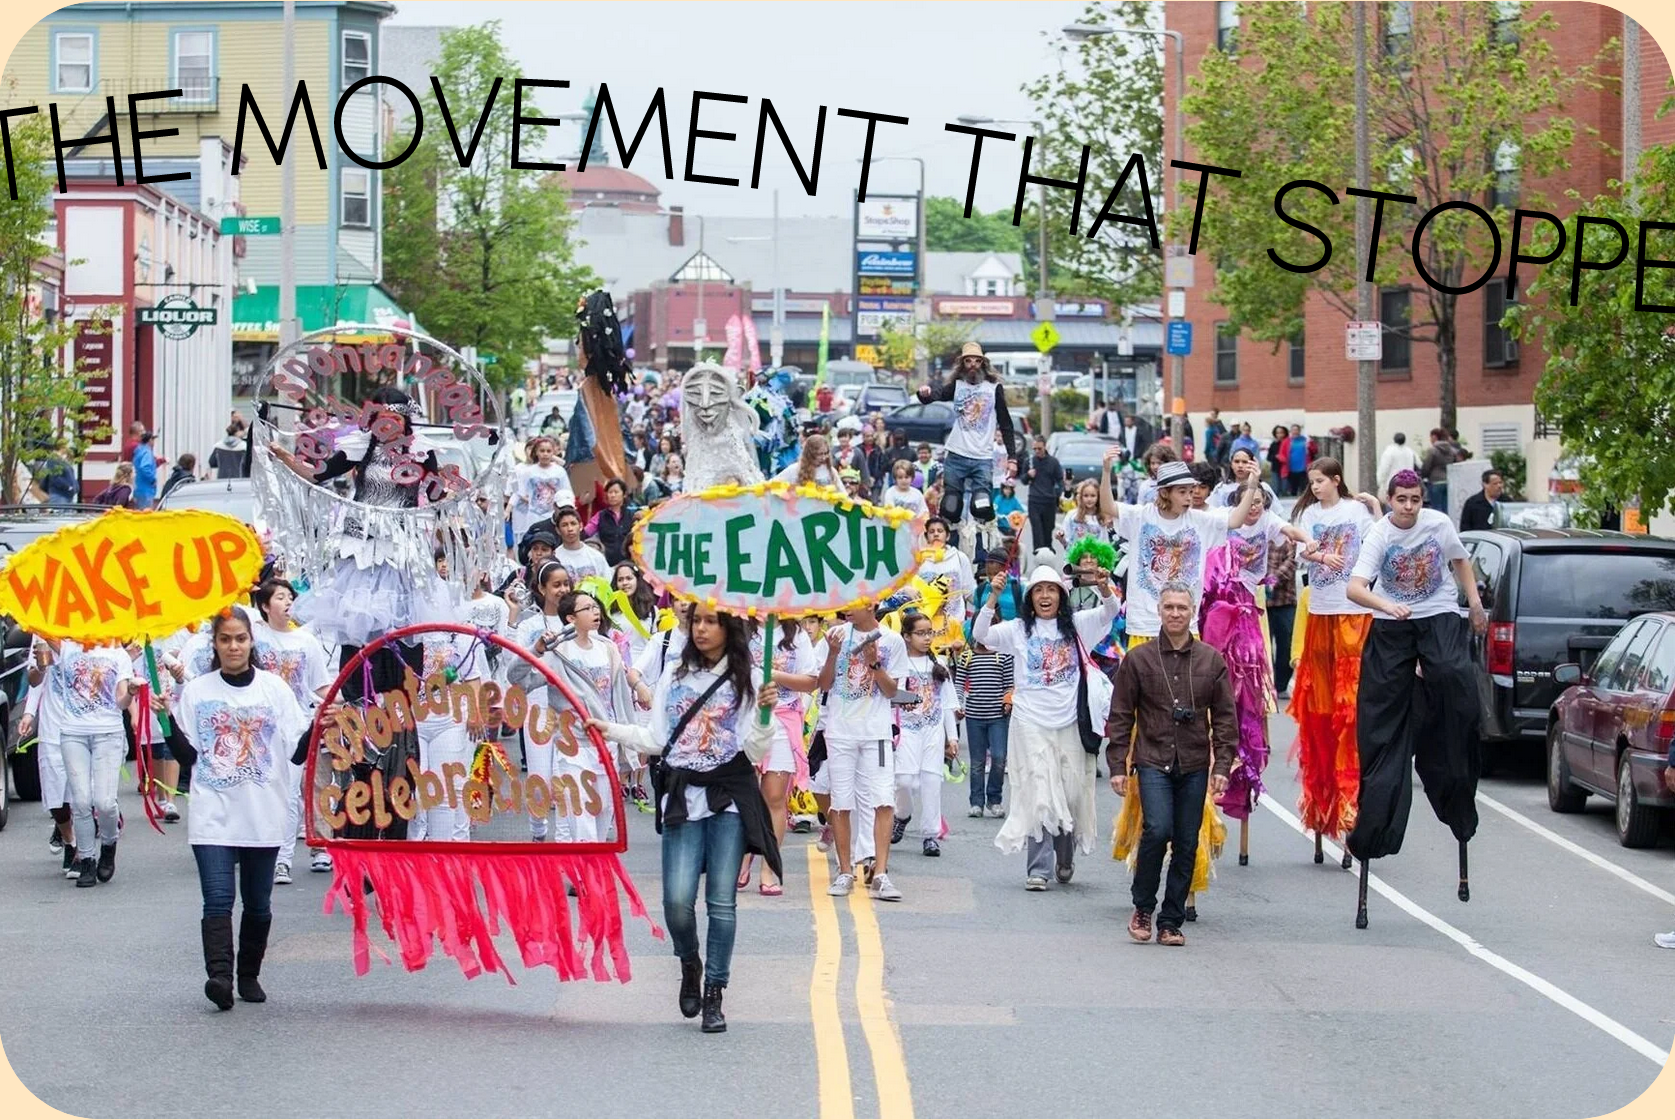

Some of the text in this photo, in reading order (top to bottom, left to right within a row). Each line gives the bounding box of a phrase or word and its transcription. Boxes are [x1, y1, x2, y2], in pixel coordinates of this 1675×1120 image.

[238, 219, 260, 232] WISE
[141, 310, 213, 322] LIQUOR
[271, 341, 491, 441] spontaneous
[8, 531, 247, 627] WAKE UP
[648, 502, 899, 597] THE EARTH
[1516, 670, 1551, 678] DODGE
[323, 665, 579, 772] spontaneous
[320, 756, 603, 829] celebrations
